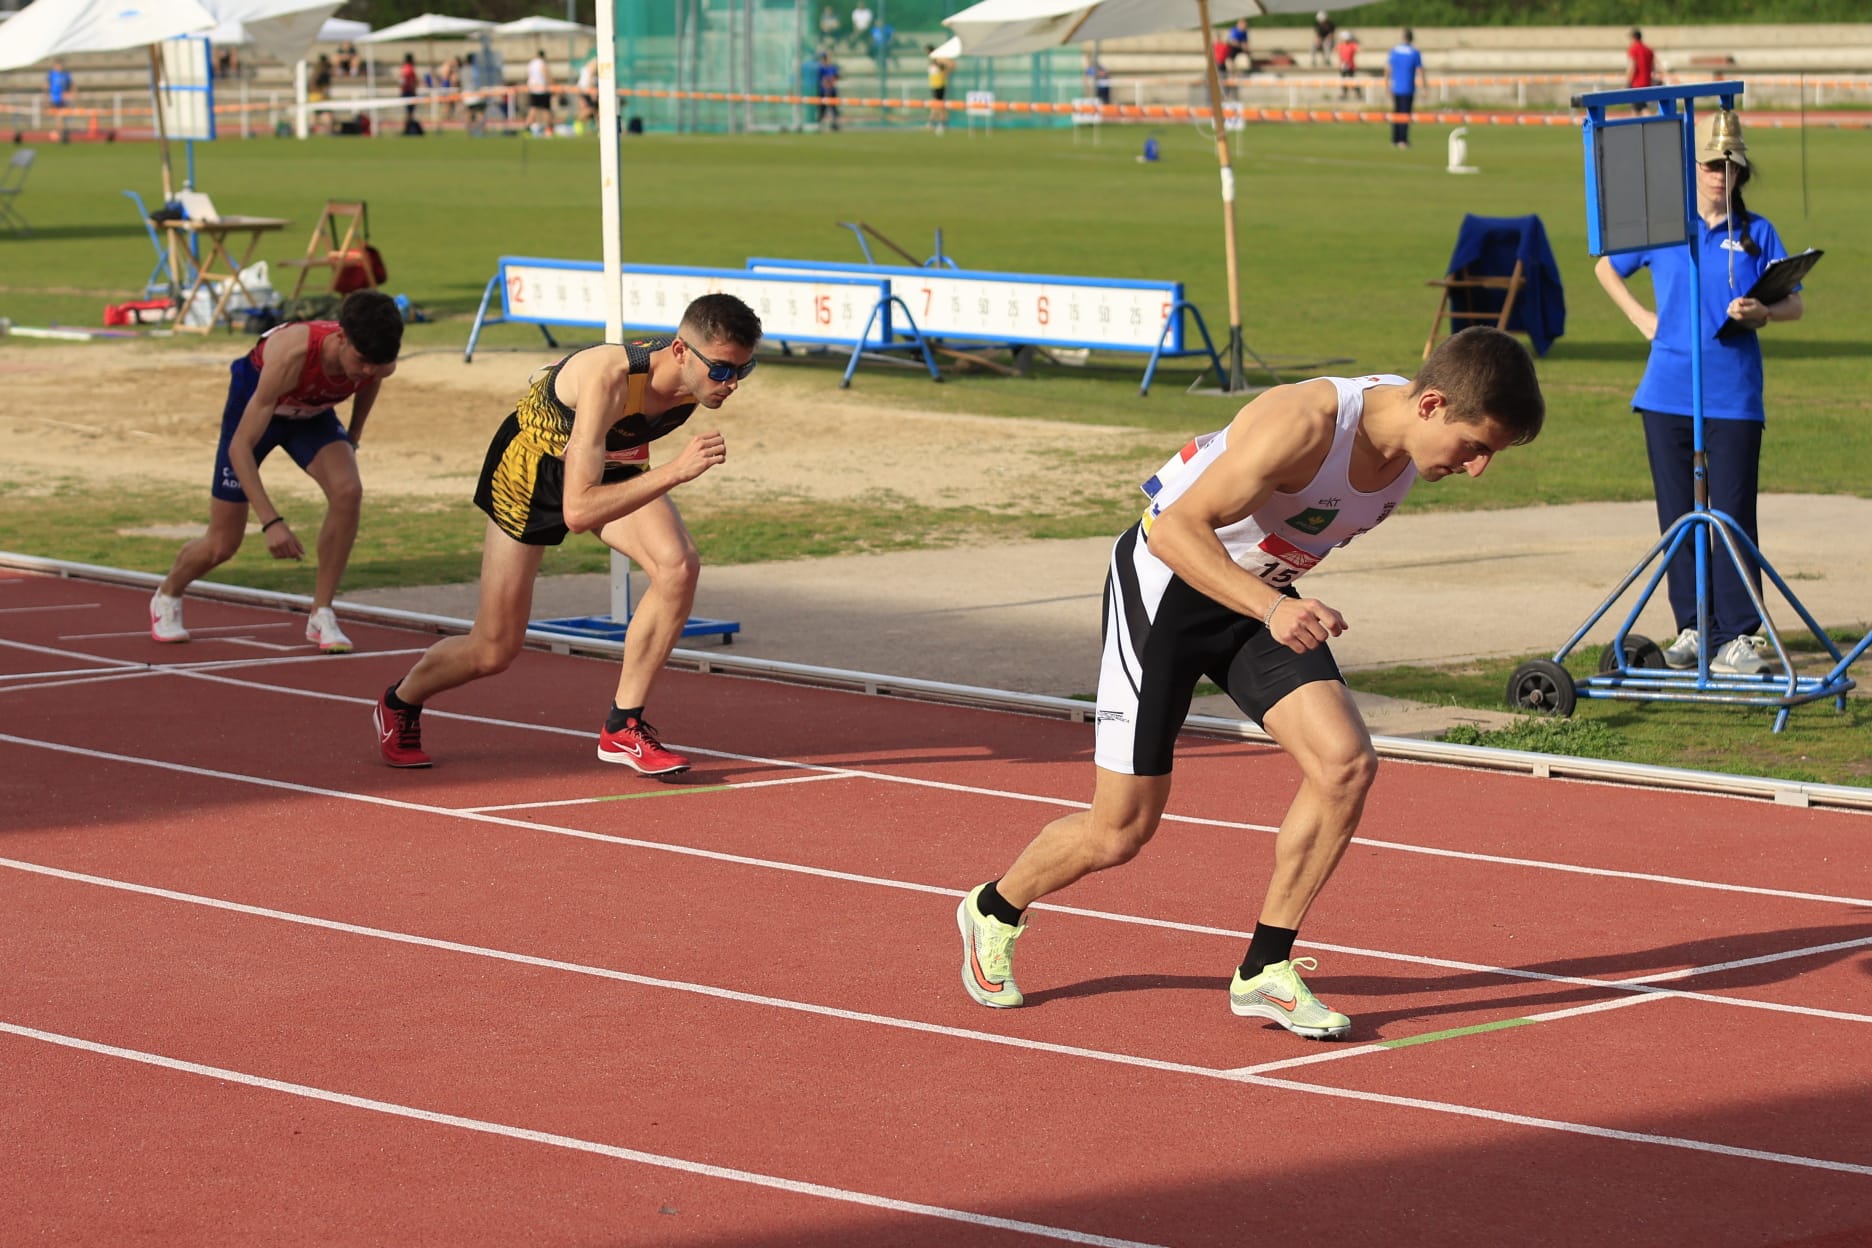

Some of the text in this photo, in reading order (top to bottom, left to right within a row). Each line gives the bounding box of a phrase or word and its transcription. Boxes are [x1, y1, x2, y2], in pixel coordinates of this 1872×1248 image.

[508, 276, 524, 303] 12
[814, 295, 832, 325] 15
[921, 288, 932, 317] 7
[1037, 296, 1050, 325] 6
[1259, 562, 1298, 582] 15
